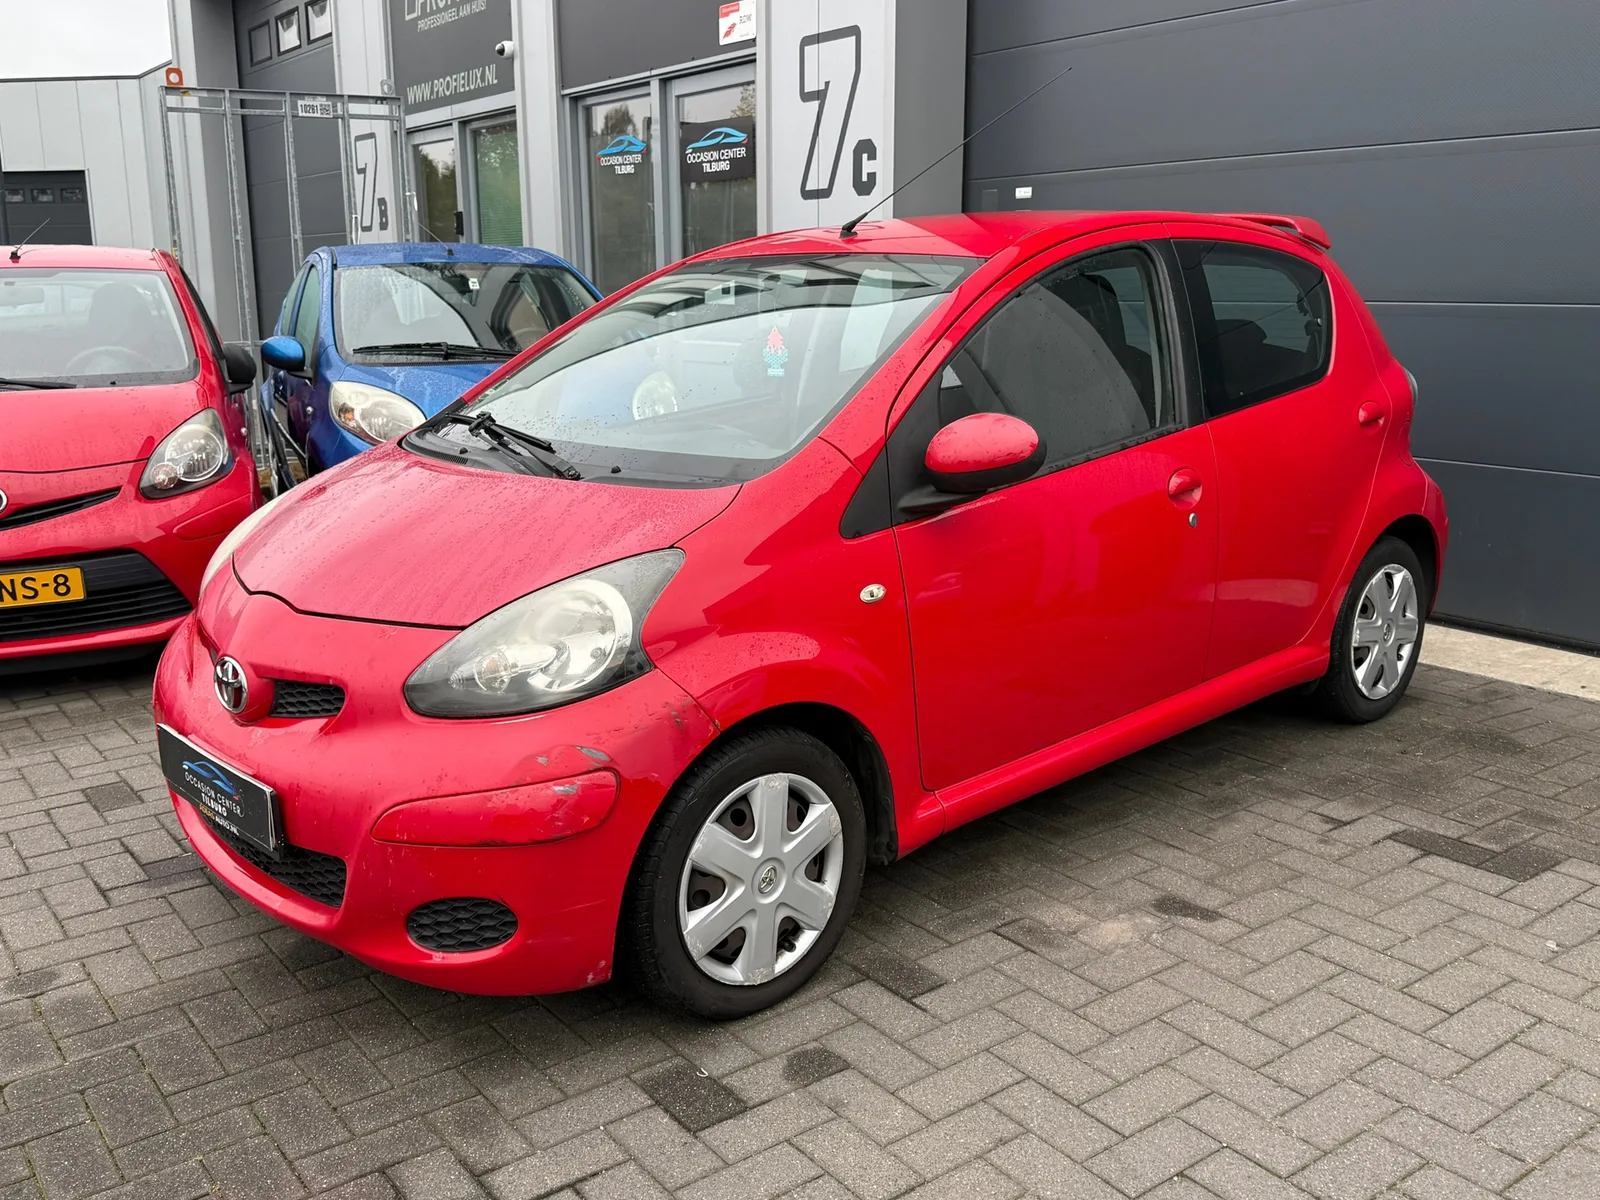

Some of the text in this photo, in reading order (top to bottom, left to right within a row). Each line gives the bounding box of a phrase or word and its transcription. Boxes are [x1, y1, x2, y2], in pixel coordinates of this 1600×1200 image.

[417, 7, 459, 32] PROFESSIONEEL
[459, 3, 471, 18] AAN
[407, 63, 498, 105] WWW.PROFIELUX.NL
[600, 154, 642, 166] OCCASION CENTER
[686, 147, 747, 163] OCCASION CENTER
[614, 164, 635, 174] TILBURG
[702, 160, 730, 173] TILBURG
[185, 772, 216, 799] OCCASION
[217, 793, 241, 816] CENTER
[201, 793, 227, 817] TILBURG
